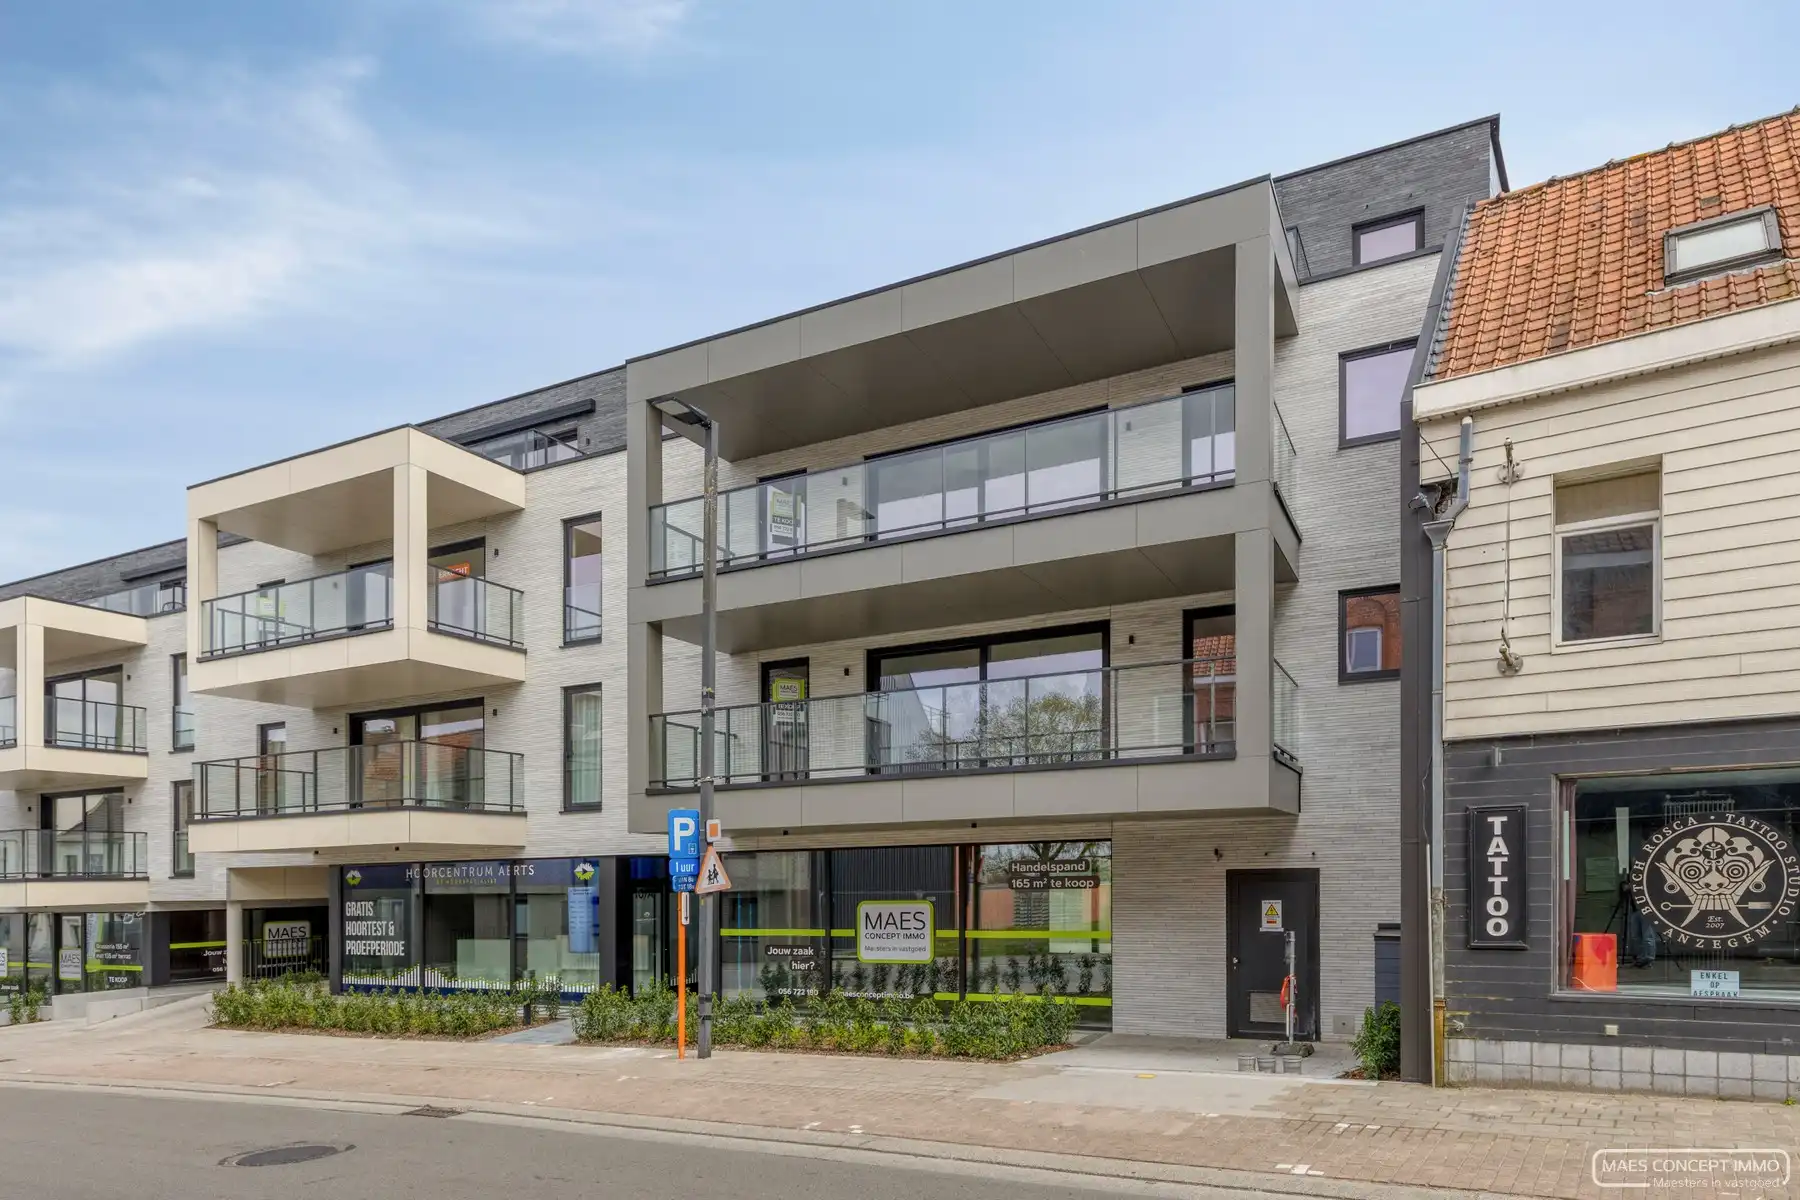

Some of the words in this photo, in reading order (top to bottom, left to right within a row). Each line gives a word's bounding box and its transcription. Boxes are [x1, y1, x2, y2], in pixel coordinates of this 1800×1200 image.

[674, 817, 695, 851] P
[405, 865, 493, 879] HOORCENTRUM
[498, 864, 535, 877] AERTS
[675, 861, 679, 873] 1
[680, 863, 695, 873] uur
[1011, 861, 1086, 874] Handelspand
[1632, 860, 1652, 916] BUTCH
[1642, 815, 1698, 853] ROSCA
[1725, 813, 1788, 851] TATTOO
[1777, 855, 1800, 917] STUDIO
[1486, 816, 1510, 937] TATTOO
[1011, 878, 1031, 888] 165
[1033, 877, 1048, 888] m²
[1050, 879, 1062, 888] te
[1065, 877, 1095, 890] koop
[345, 901, 374, 917] GRATIS
[865, 911, 926, 931] MAES
[1705, 922, 1726, 930] 2007
[268, 926, 307, 939] MAES
[345, 920, 388, 936] HOORTEST
[388, 921, 395, 936] &
[864, 932, 901, 940] CONCEPT
[903, 932, 926, 940] IMMO
[1663, 924, 1772, 949] ANZEGEM
[203, 949, 222, 957] Jouw
[345, 940, 405, 956] PROEFPERIODE
[767, 946, 791, 955] Jouw
[793, 946, 814, 956] zaak
[899, 945, 927, 954] vastgoed
[791, 961, 815, 970] hier?
[1700, 971, 1728, 980] ENKEL
[778, 987, 792, 995] 056
[793, 988, 805, 996] 722
[1710, 981, 1720, 989] OP
[840, 990, 915, 1000] maesconceptimo.be
